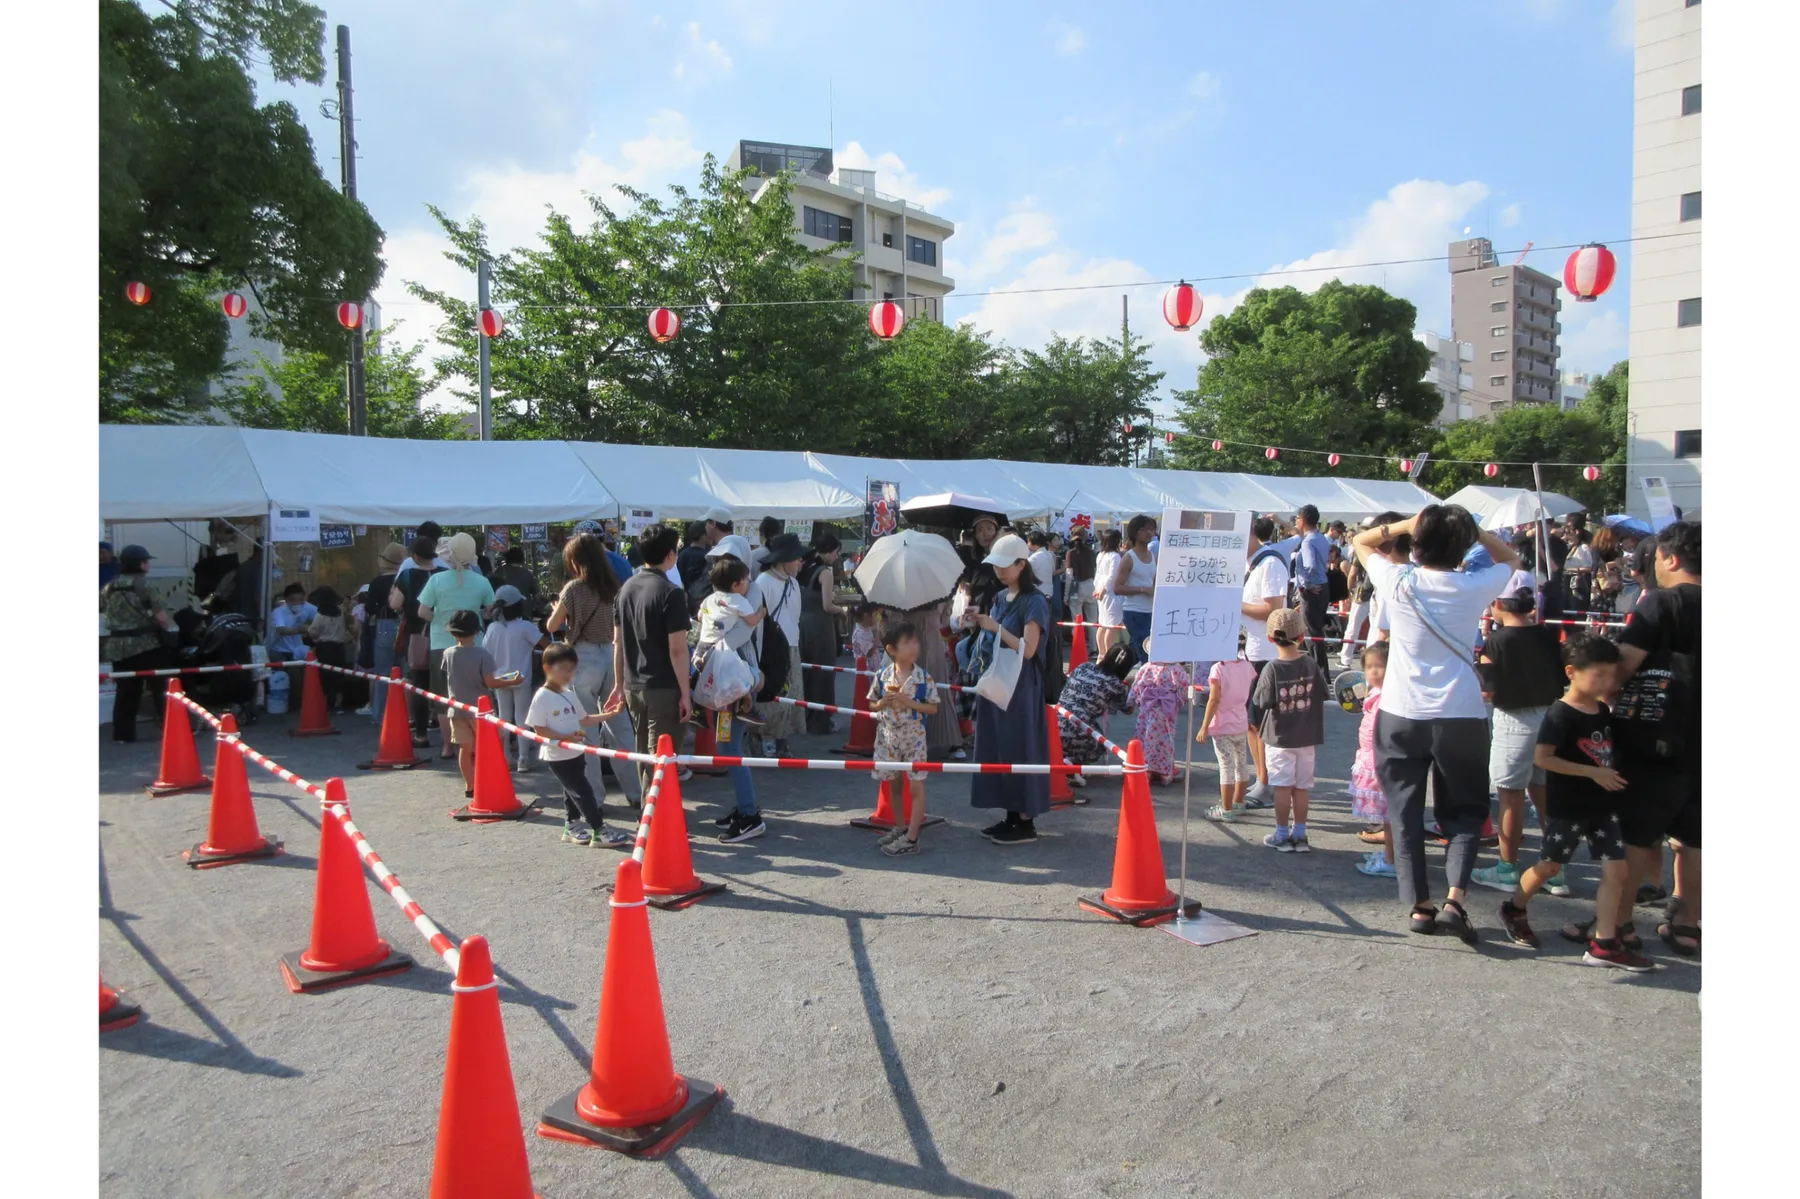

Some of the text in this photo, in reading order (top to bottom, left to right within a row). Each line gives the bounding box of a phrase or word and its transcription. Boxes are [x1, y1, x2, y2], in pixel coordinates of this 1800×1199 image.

[1168, 534, 1243, 549] 石浜二丁目町会
[1178, 555, 1227, 568] こちらから
[1165, 571, 1237, 584] お入りください
[1158, 607, 1234, 642] 王冠つり
